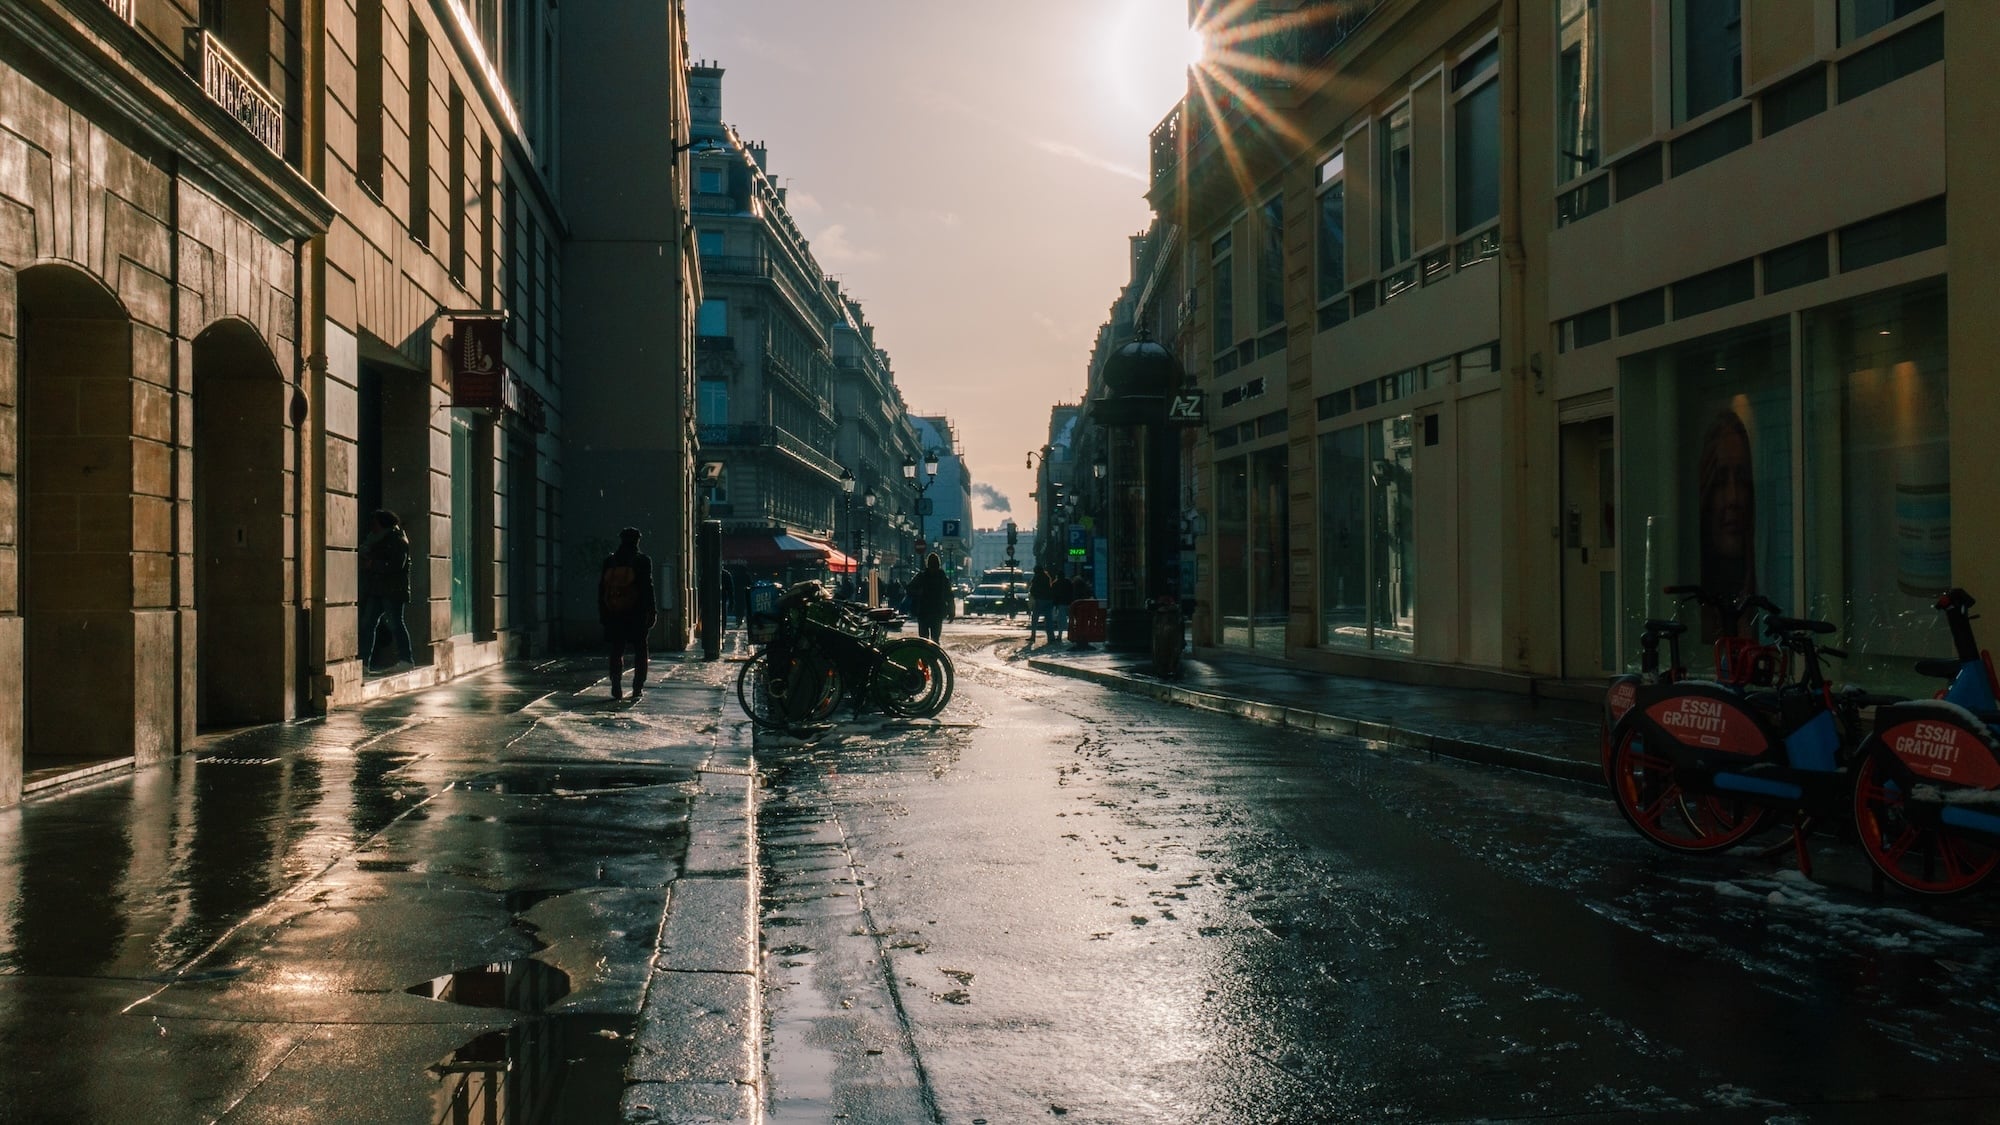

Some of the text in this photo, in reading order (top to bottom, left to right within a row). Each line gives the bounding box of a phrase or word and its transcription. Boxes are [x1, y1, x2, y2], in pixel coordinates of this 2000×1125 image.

[1169, 395, 1201, 417] AZ
[946, 522, 955, 534] P
[1070, 531, 1080, 543] P
[1680, 698, 1722, 718] ESSAI
[1914, 723, 1957, 745] ESSAI
